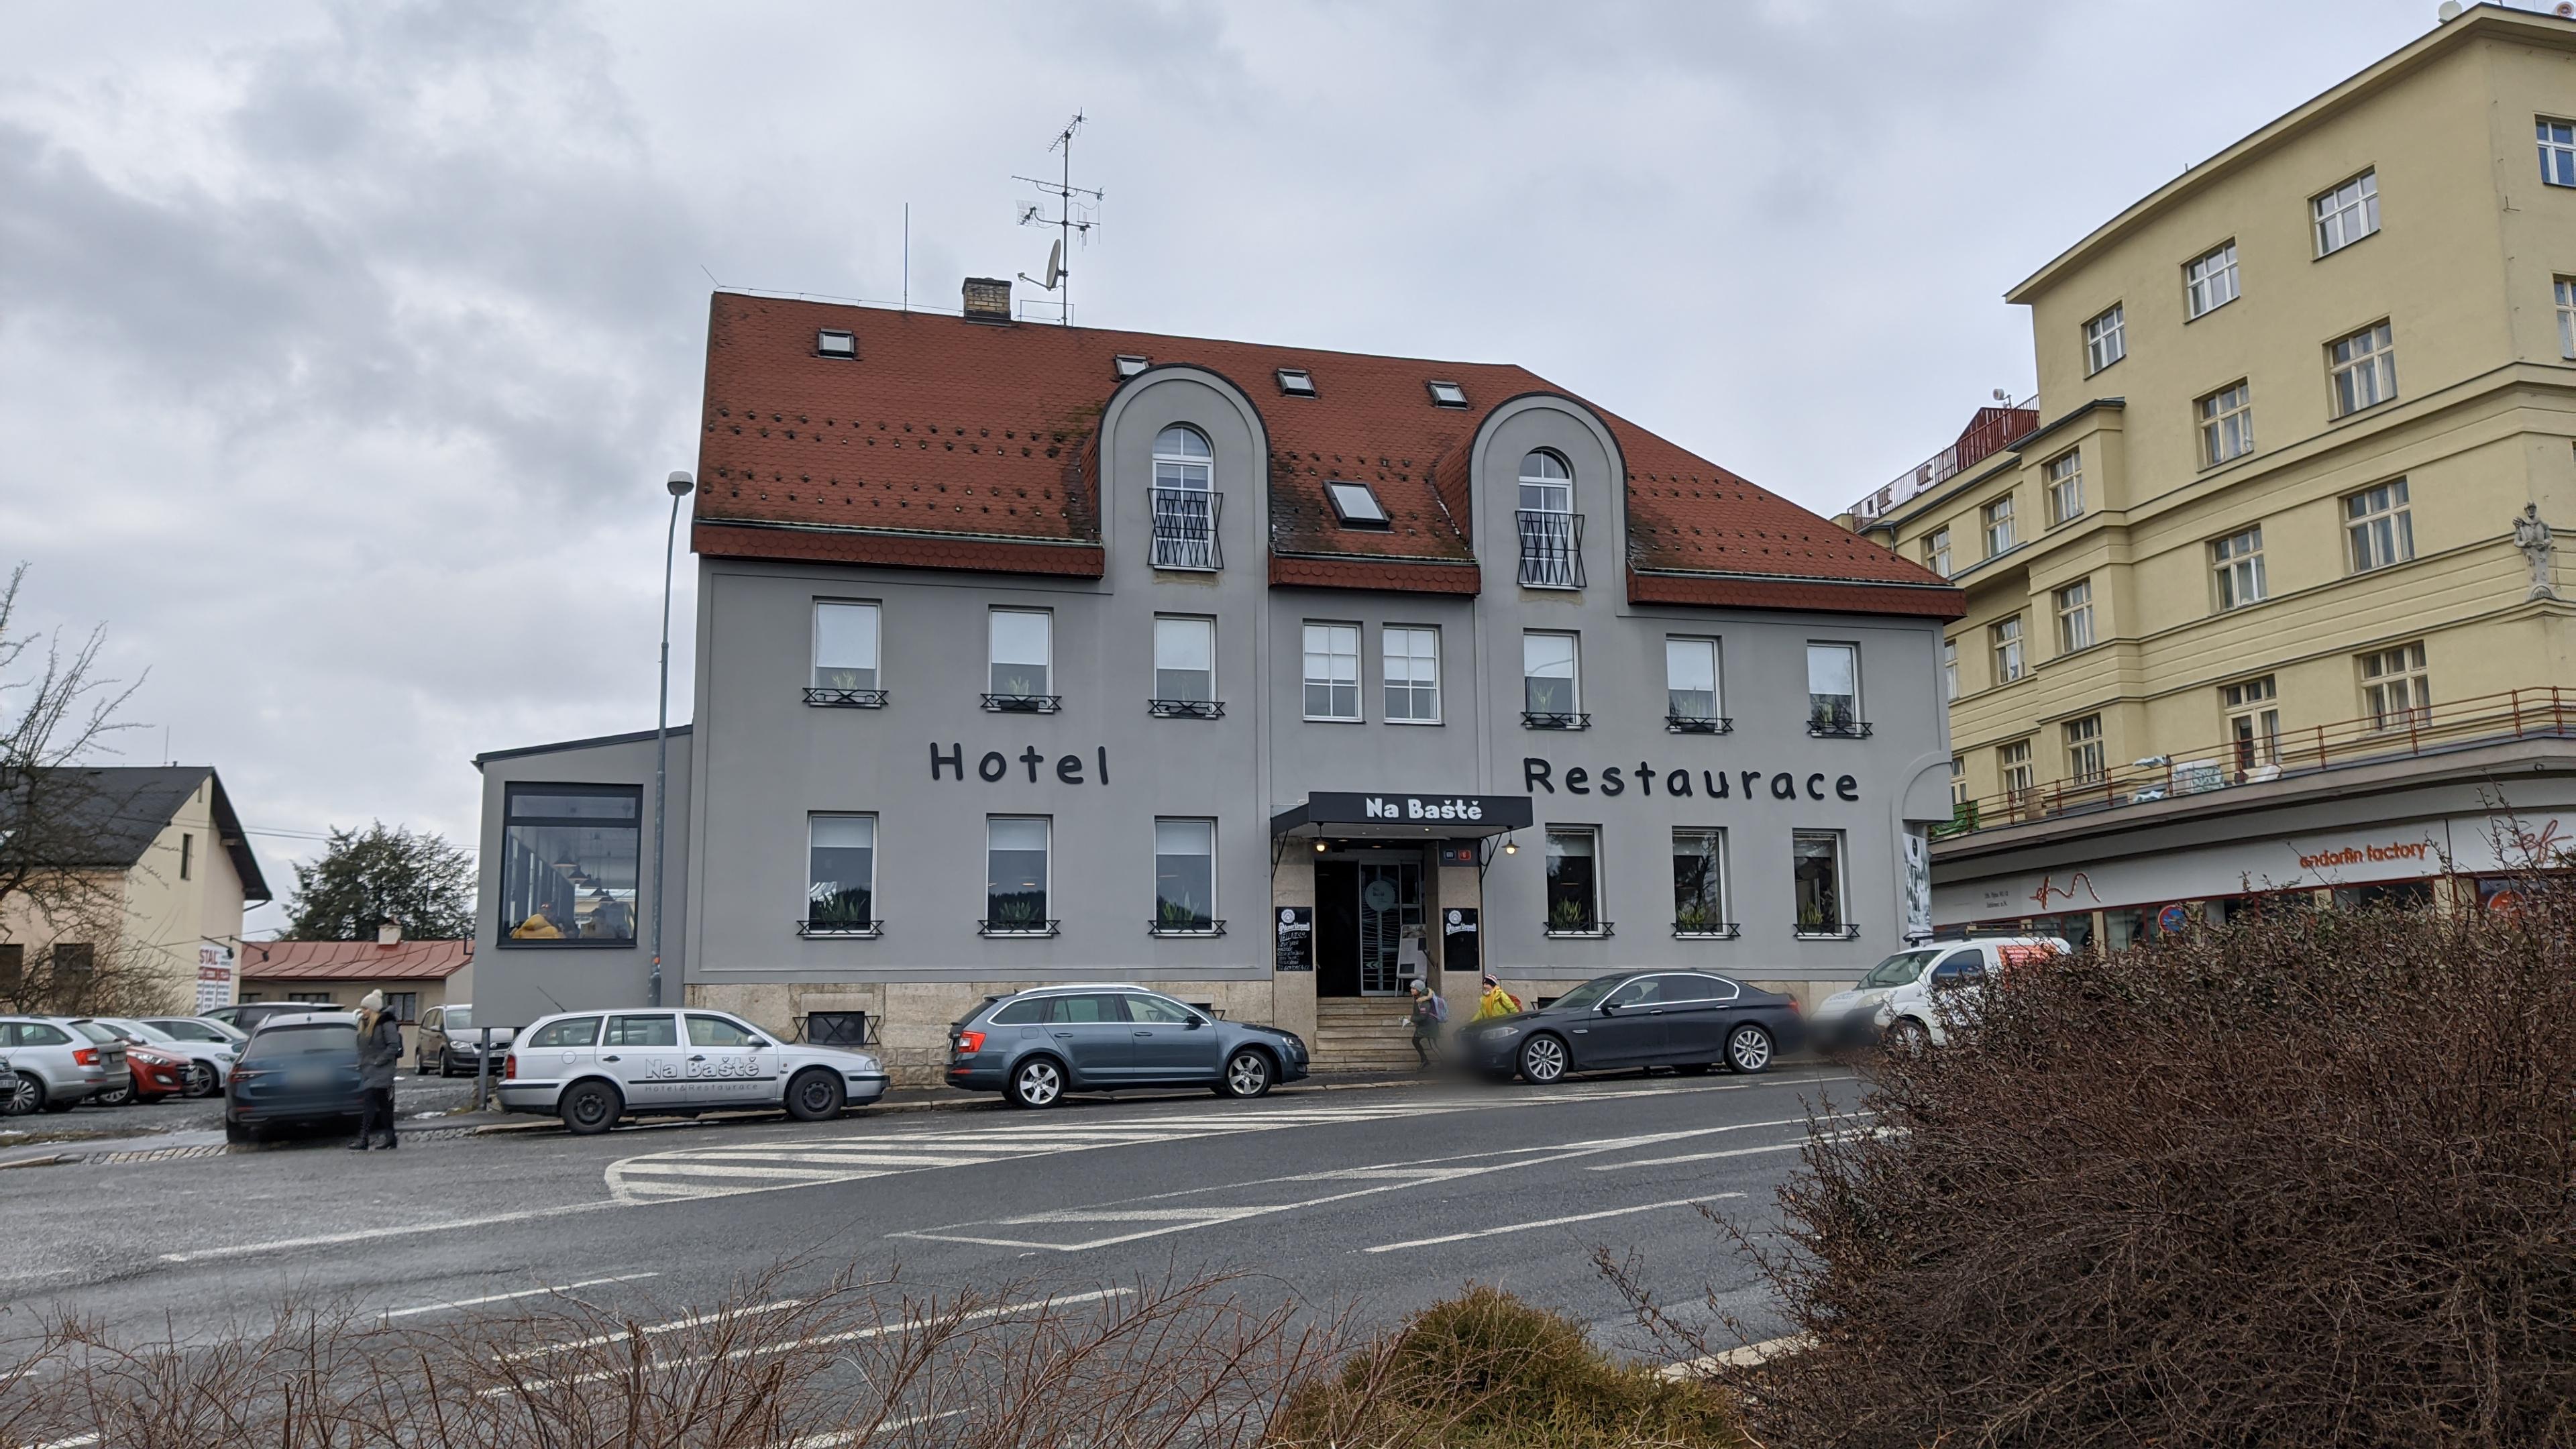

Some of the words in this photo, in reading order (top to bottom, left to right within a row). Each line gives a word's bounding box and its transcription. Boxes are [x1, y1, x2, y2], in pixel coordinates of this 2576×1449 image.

[930, 742, 1110, 786] Hotel
[1523, 757, 1860, 802] Restaurace
[1366, 797, 1399, 818] Na
[1407, 799, 1483, 820] Baště
[2366, 841, 2429, 863] factory
[645, 1057, 678, 1079] Na
[686, 1056, 759, 1078] Baště
